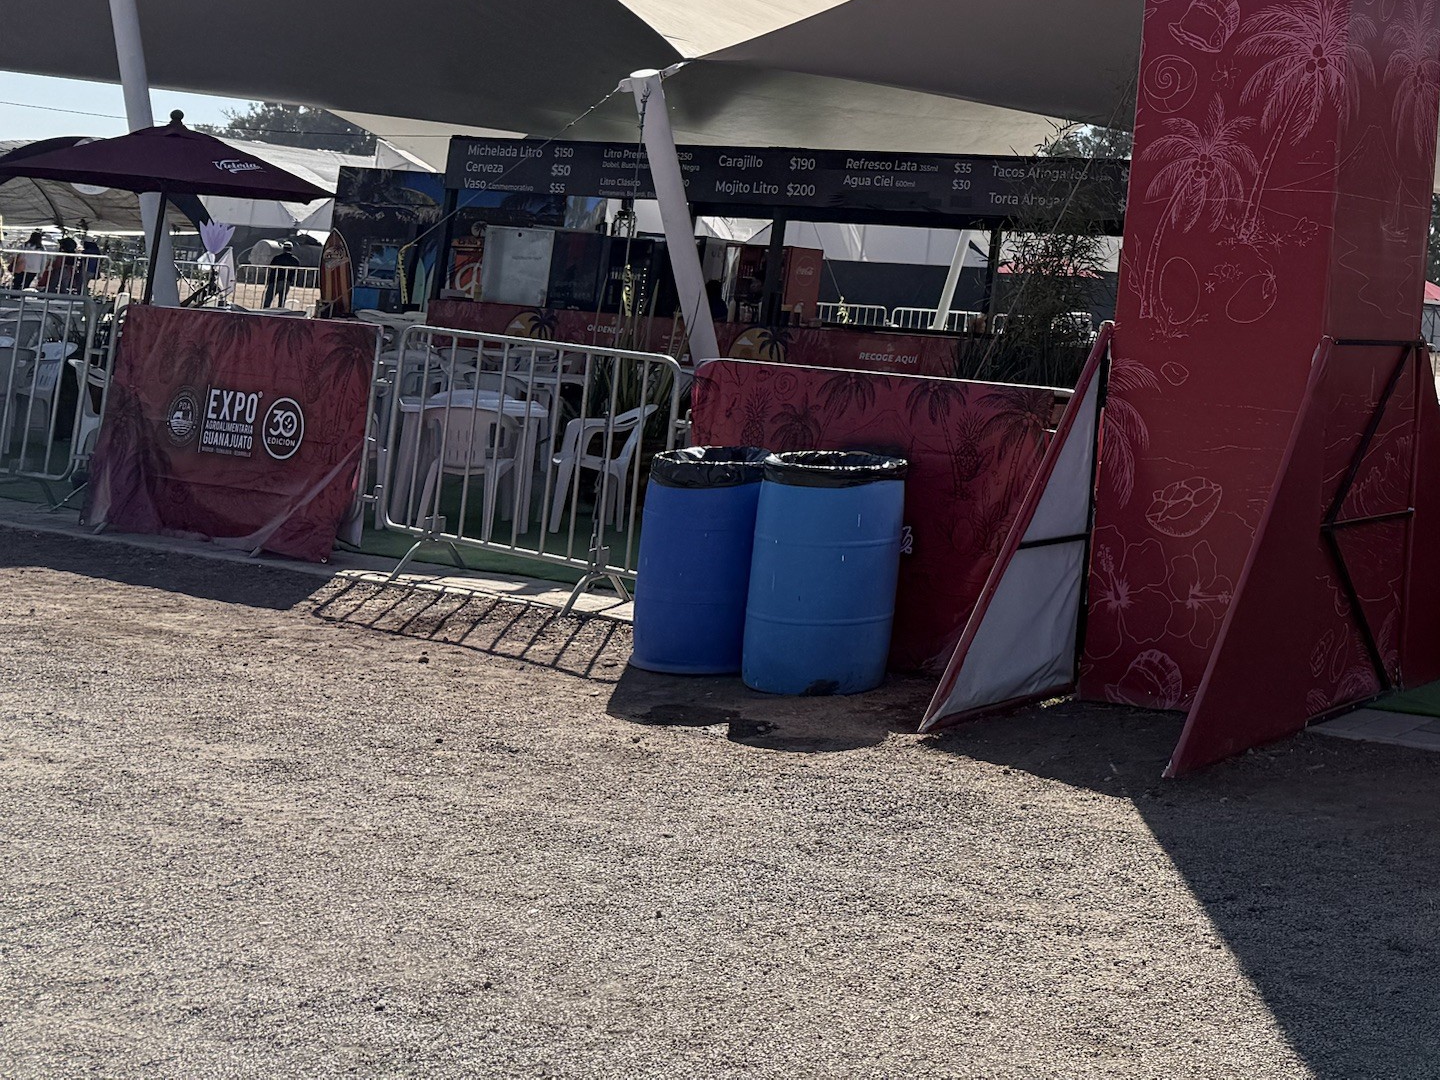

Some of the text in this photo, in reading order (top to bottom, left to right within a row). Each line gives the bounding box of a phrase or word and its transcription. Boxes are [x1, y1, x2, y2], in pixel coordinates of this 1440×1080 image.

[467, 145, 543, 158] Michelada Litro
[553, 147, 575, 159] $150
[604, 149, 622, 158] Litro
[465, 161, 504, 173] Cerveza
[718, 155, 764, 171] Carajillo
[789, 157, 816, 171] $190
[846, 158, 892, 170] Refresco
[894, 160, 917, 171] Lata
[954, 161, 972, 174] $35
[551, 164, 571, 177] $50
[992, 165, 1025, 178] Tacos
[463, 177, 487, 189] Vaso
[600, 177, 616, 186] Litro
[843, 174, 871, 188] Agua
[873, 175, 894, 187] Ciel
[952, 179, 971, 190] $30
[549, 182, 566, 195] $55
[715, 180, 779, 196] Mojito Litro
[786, 182, 816, 197] $200
[989, 192, 1018, 205] Torta
[859, 352, 919, 364] RECOGE AQUÍ
[270, 409, 298, 438] 30
[202, 430, 253, 450] GUANAJUATO
